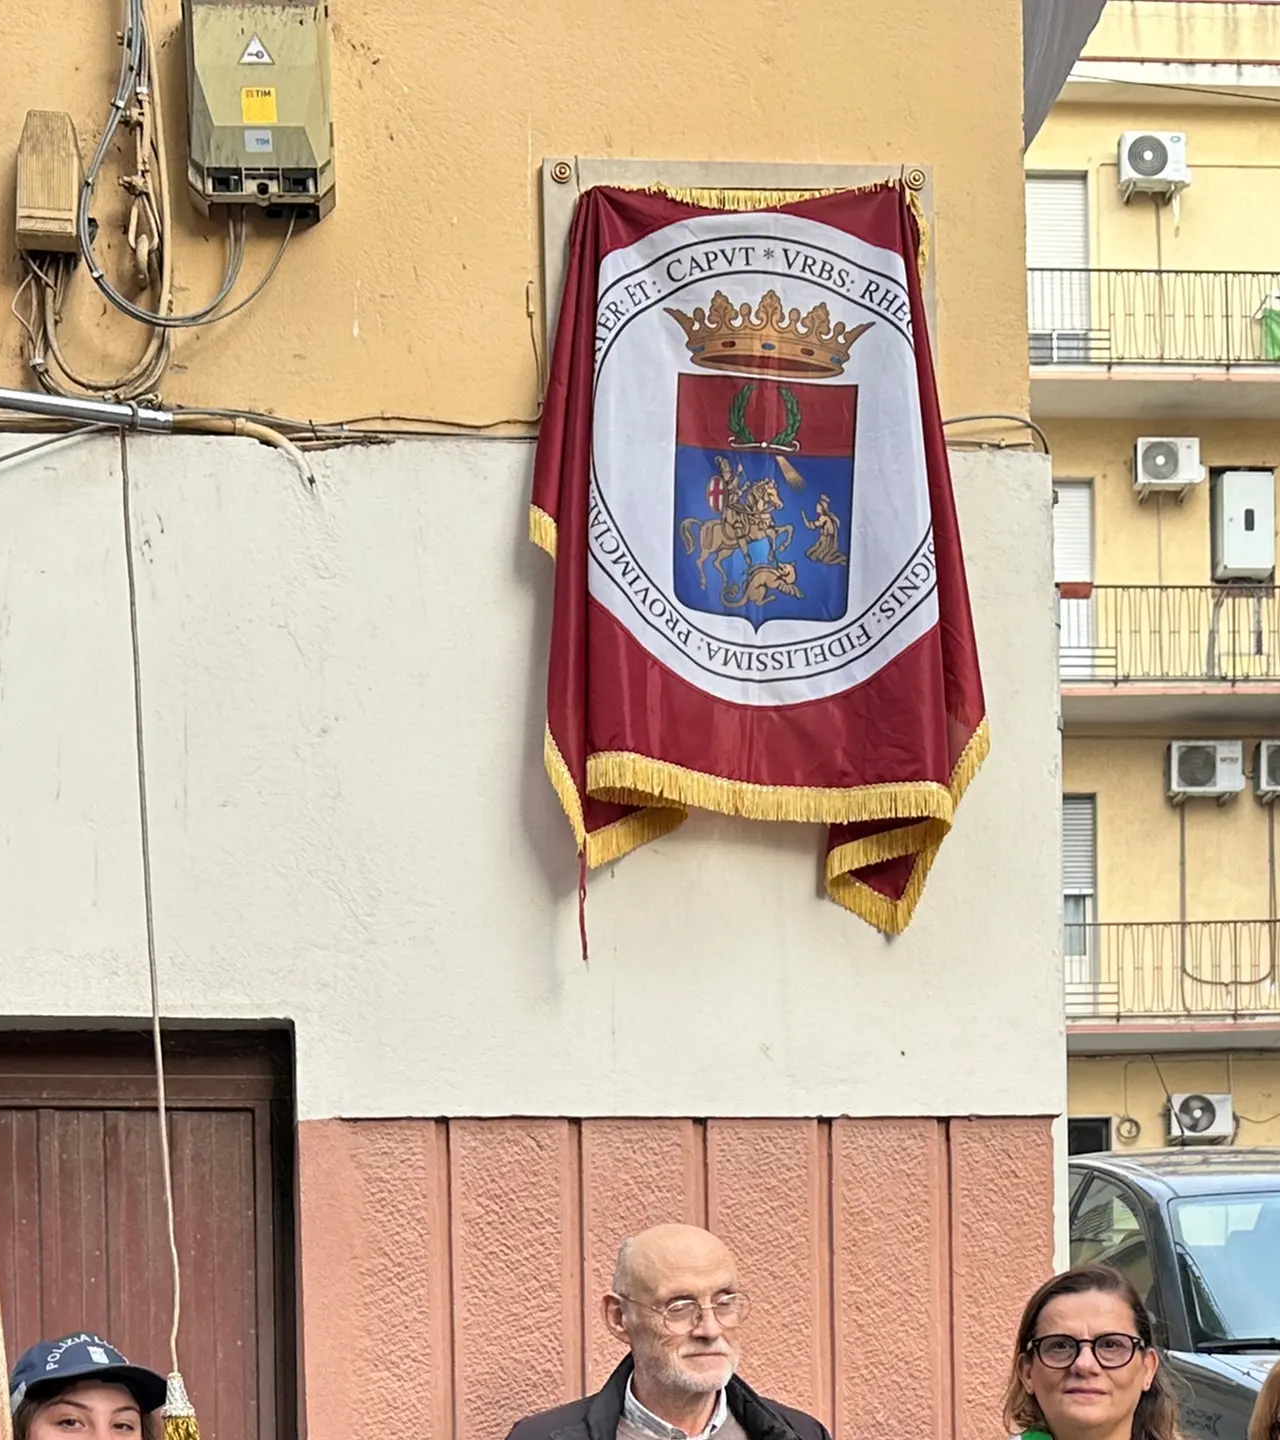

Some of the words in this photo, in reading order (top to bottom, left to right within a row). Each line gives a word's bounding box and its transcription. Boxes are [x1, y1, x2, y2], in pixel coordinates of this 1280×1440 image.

[255, 90, 271, 98] TIM
[623, 279, 662, 307] ET:
[666, 246, 755, 283] CAPVT
[782, 247, 855, 293] VRBS:
[698, 622, 873, 673] FIDELISSIMA:
[45, 1333, 92, 1371] POLIZIA
